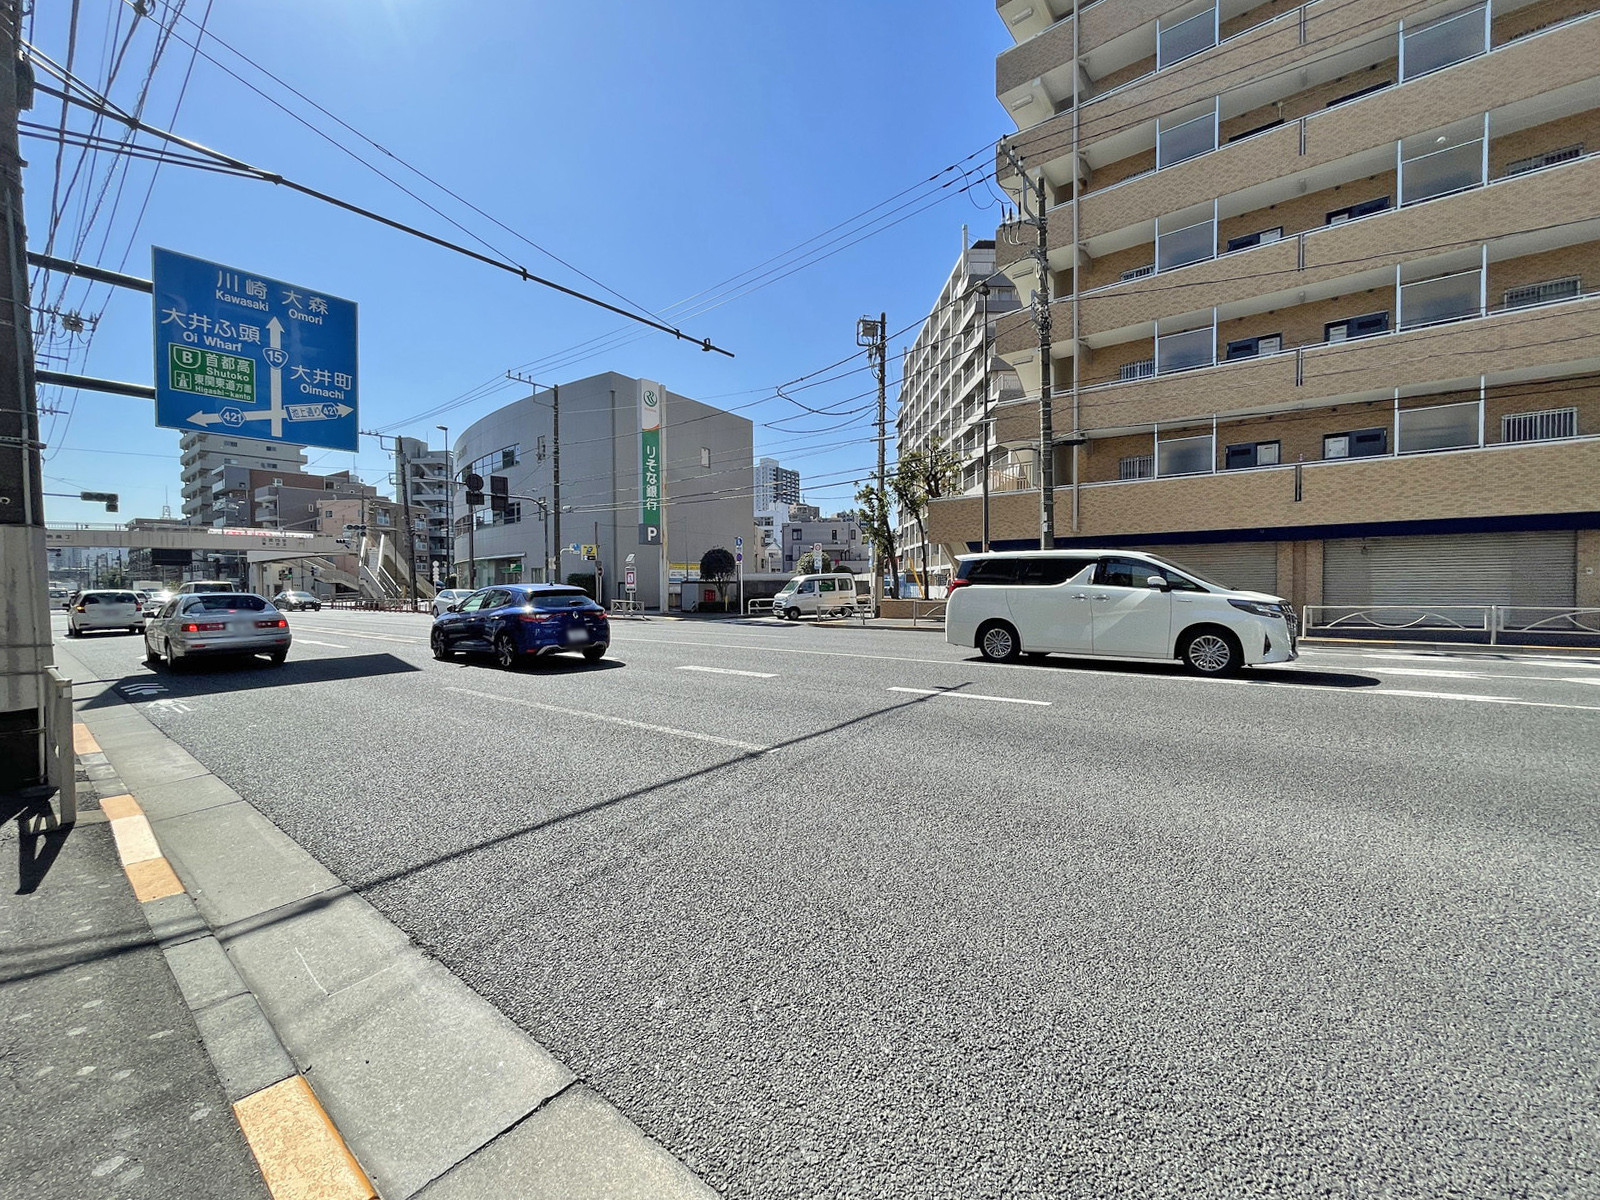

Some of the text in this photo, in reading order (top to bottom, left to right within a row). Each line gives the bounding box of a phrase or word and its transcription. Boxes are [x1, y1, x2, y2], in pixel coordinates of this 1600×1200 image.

[217, 270, 267, 300] 川崎
[215, 289, 269, 312] Kawasaki
[281, 290, 328, 315] 大森
[288, 308, 323, 325] Omori
[161, 307, 260, 345] 大井ふ頭
[183, 331, 242, 352] Oi Wharf
[182, 351, 193, 364] B
[204, 352, 250, 374] 首都高
[267, 350, 283, 363] 15
[206, 366, 249, 382] Shutoko
[290, 364, 352, 390] 大井町
[194, 373, 252, 394] 東関東道方面
[300, 383, 345, 400] Oimachi
[195, 385, 251, 401] Higashi-kanto
[223, 411, 242, 423] 421
[291, 406, 321, 419] 池上通り
[323, 406, 338, 415] 421
[645, 445, 658, 511] りそな銀行
[646, 526, 658, 541] P
